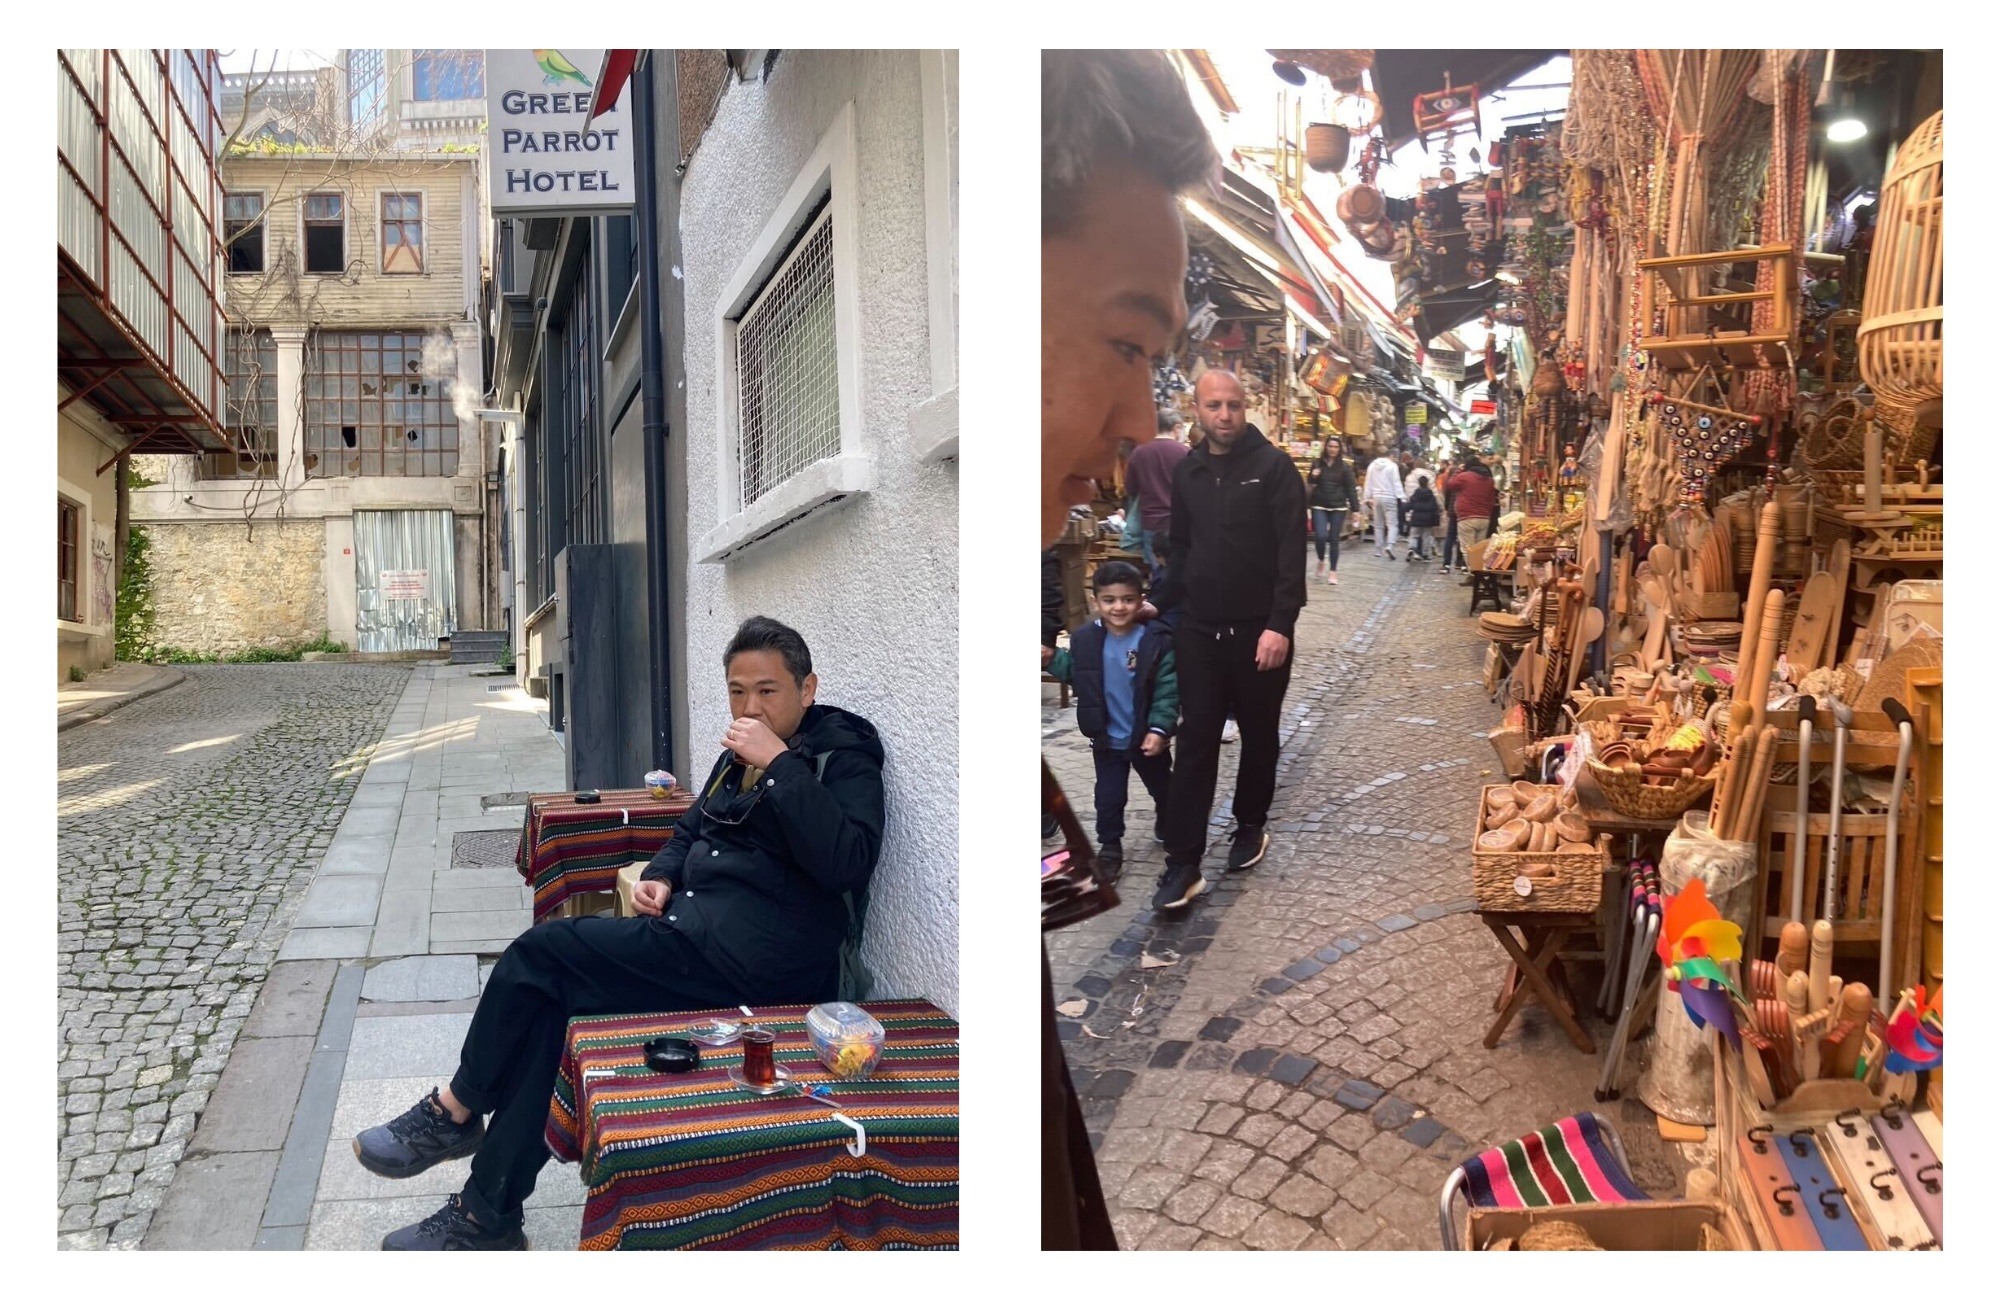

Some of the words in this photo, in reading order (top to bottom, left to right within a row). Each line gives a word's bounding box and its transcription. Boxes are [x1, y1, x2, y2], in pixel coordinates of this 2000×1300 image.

[501, 89, 618, 115] GREE
[501, 128, 619, 153] PARROT
[505, 168, 619, 193] HOTEL
